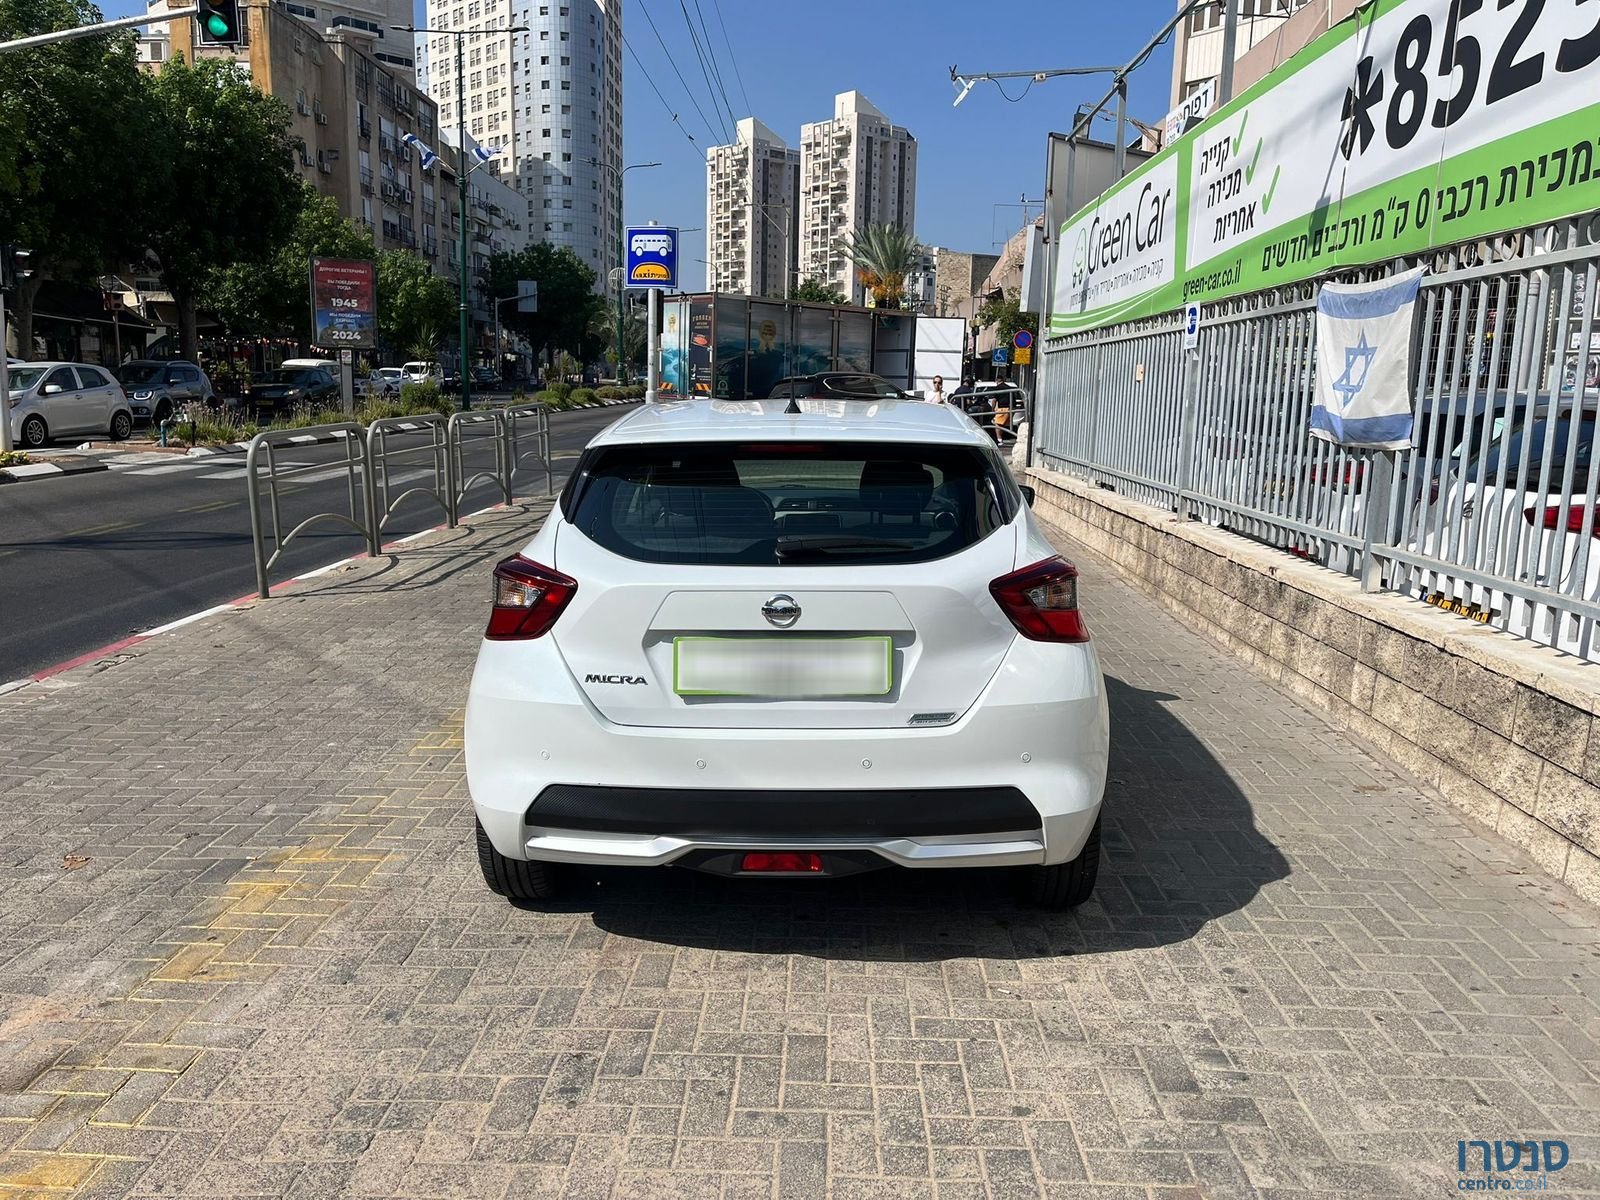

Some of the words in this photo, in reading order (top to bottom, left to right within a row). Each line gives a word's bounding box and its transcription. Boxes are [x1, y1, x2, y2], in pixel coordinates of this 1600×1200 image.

[1200, 136, 1231, 176] קנייה
[1495, 137, 1600, 207] מכירת
[1207, 168, 1242, 208] מכירה
[1436, 175, 1488, 222] רכבי
[1088, 212, 1132, 275] Green
[1135, 182, 1170, 252] Car
[1213, 201, 1257, 244] אחריות
[1311, 214, 1367, 257] ורכבים
[1261, 234, 1309, 272] חדשים
[1182, 258, 1242, 302] green-car.co.il
[331, 297, 358, 308] 1945
[332, 330, 361, 340] 2024
[584, 673, 649, 686] MICRA
